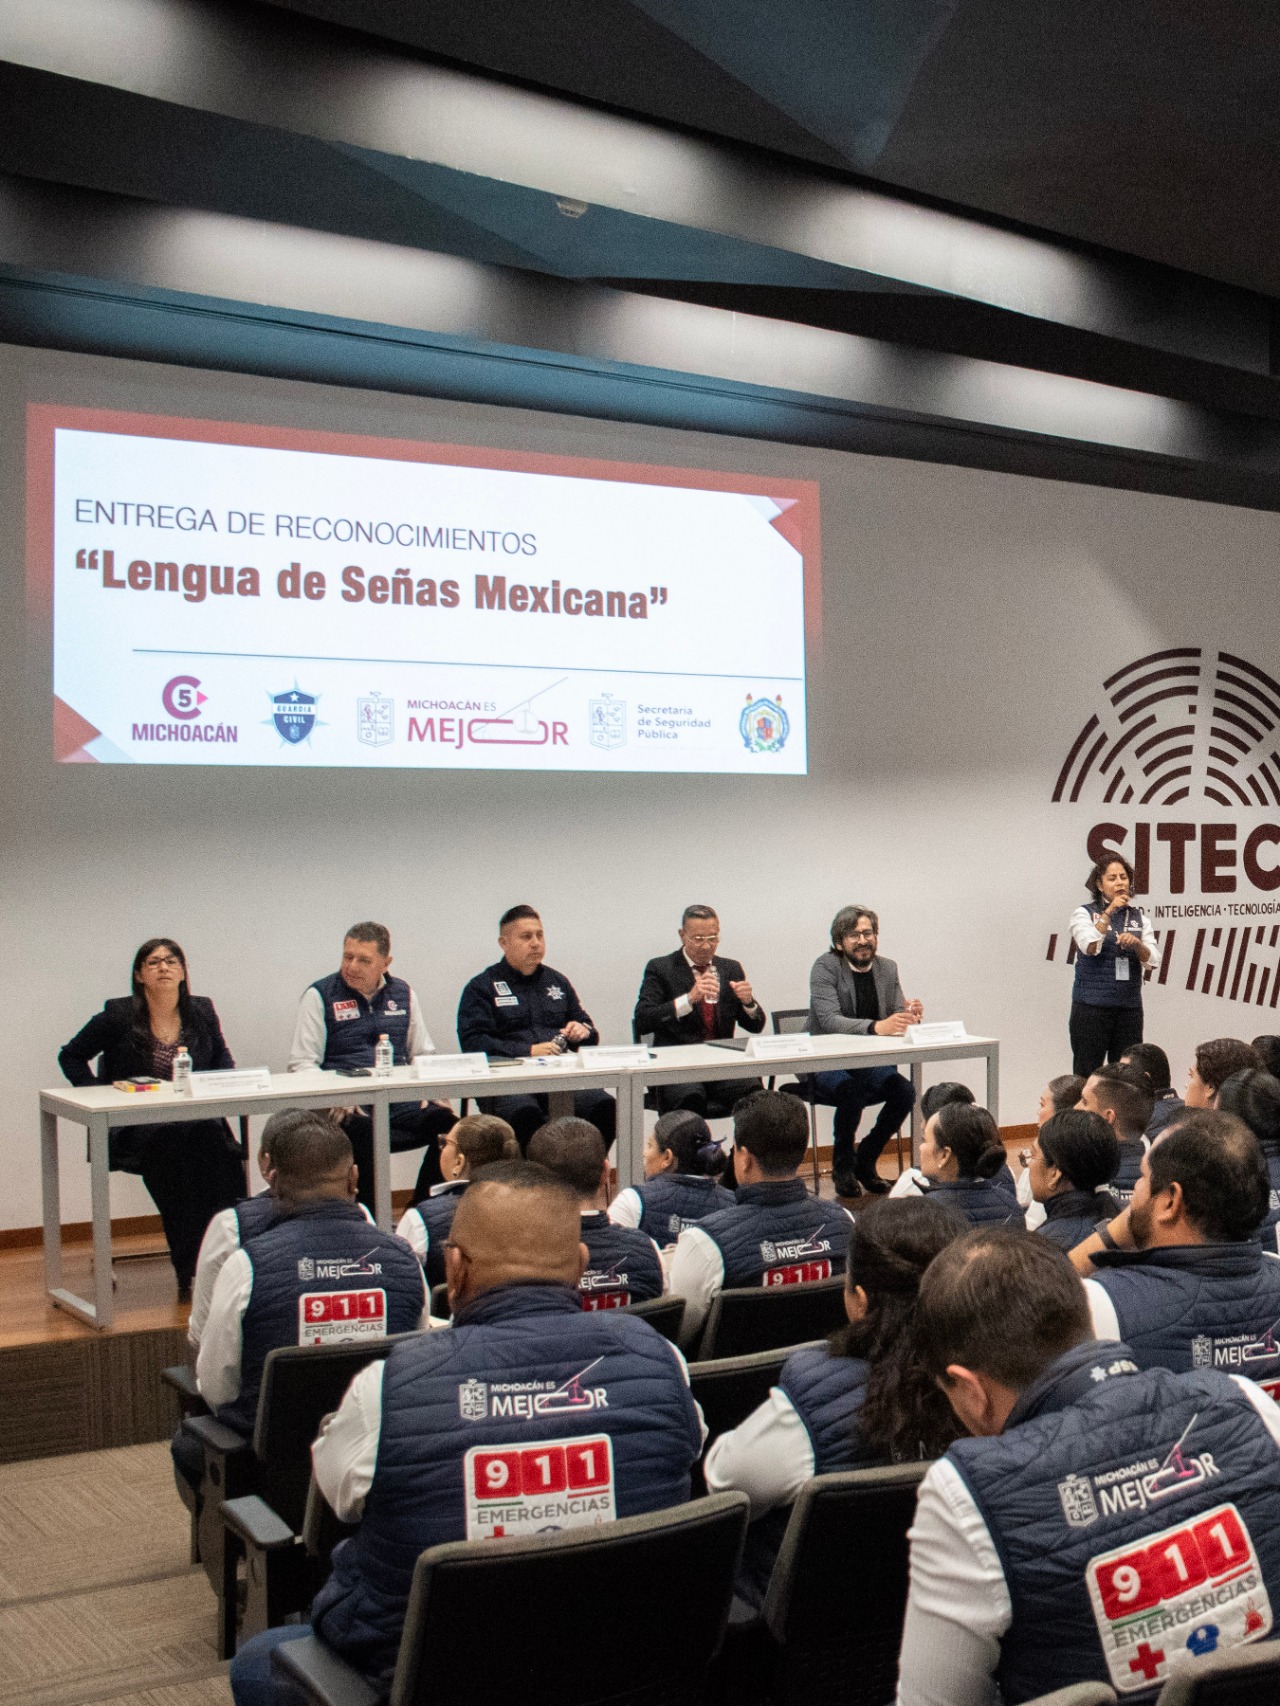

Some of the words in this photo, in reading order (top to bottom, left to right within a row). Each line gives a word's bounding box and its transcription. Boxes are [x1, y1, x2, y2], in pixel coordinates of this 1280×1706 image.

[75, 498, 218, 533] ENTREGA
[227, 511, 265, 536] DE
[275, 514, 537, 556] RECONOCIMIENTOS
[75, 548, 261, 603] “Lengua
[276, 562, 326, 601] de
[341, 565, 461, 609] Señas
[474, 574, 669, 620] Mexicana”
[276, 705, 312, 713] GUARDIA
[407, 699, 481, 712] MICHOACÁN
[484, 701, 497, 712] ES
[283, 715, 306, 724] CIVIL
[638, 717, 652, 727] de
[655, 717, 711, 730] Seguridad
[131, 722, 238, 743] MICHOACÁN
[407, 716, 570, 750] MEJOR
[638, 729, 679, 740] Pública
[1154, 903, 1222, 918] INTELIGENCIA
[316, 1262, 383, 1280] MEJOR
[772, 1265, 823, 1286] 911
[311, 1295, 376, 1317] 911
[304, 1322, 384, 1338] EMERGENCIAS
[491, 1380, 544, 1393] MICHOACÁN
[545, 1381, 556, 1390] ES
[491, 1387, 609, 1420] MEJOR
[485, 1450, 596, 1489] 911
[1094, 1460, 1149, 1486] MICHOACÁN
[1099, 1452, 1221, 1516] MEJOR
[477, 1496, 610, 1525] EMERGENCIAS
[1112, 1522, 1236, 1603] 911
[1113, 1575, 1258, 1649] EMERGENCIAS
